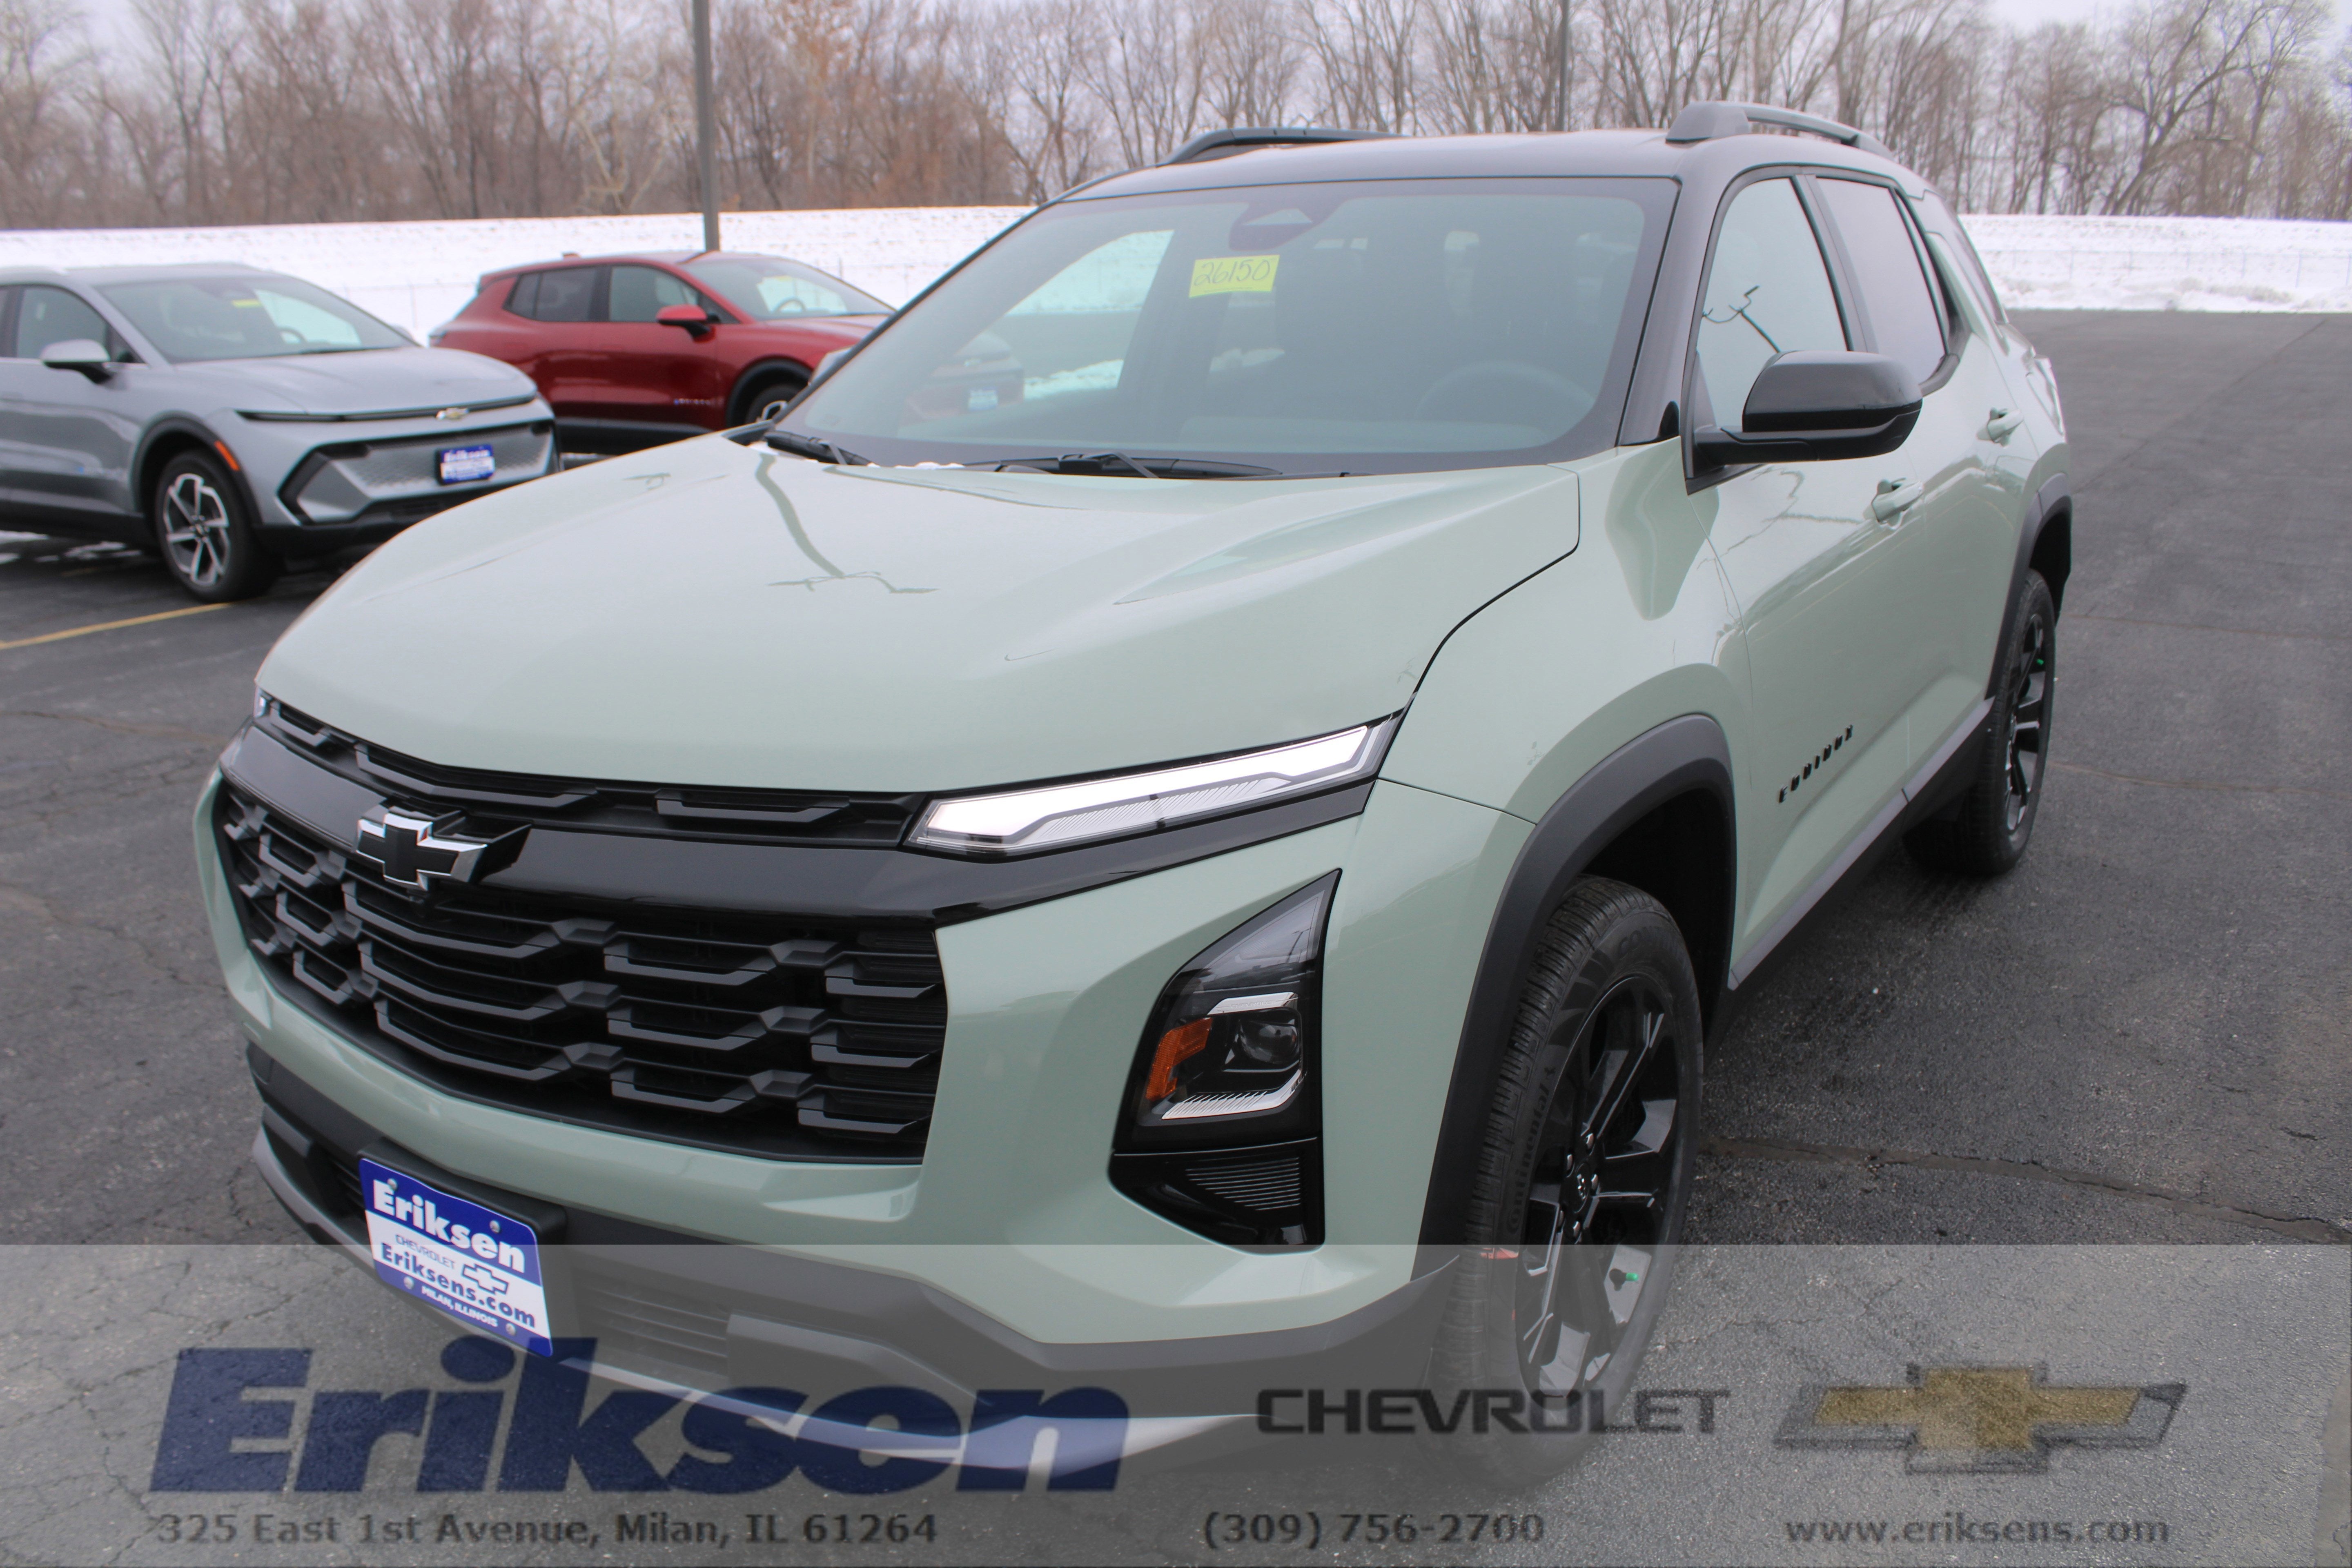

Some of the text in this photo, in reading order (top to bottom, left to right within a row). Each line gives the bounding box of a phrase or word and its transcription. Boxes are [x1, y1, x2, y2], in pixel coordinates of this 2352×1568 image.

[1194, 259, 1270, 286] 26150
[373, 1179, 525, 1274] Eriksen
[395, 1234, 455, 1270] CHEVROLET
[381, 1243, 536, 1329] Eriksens.com
[421, 1286, 499, 1327] MILAN, ILLINOIS
